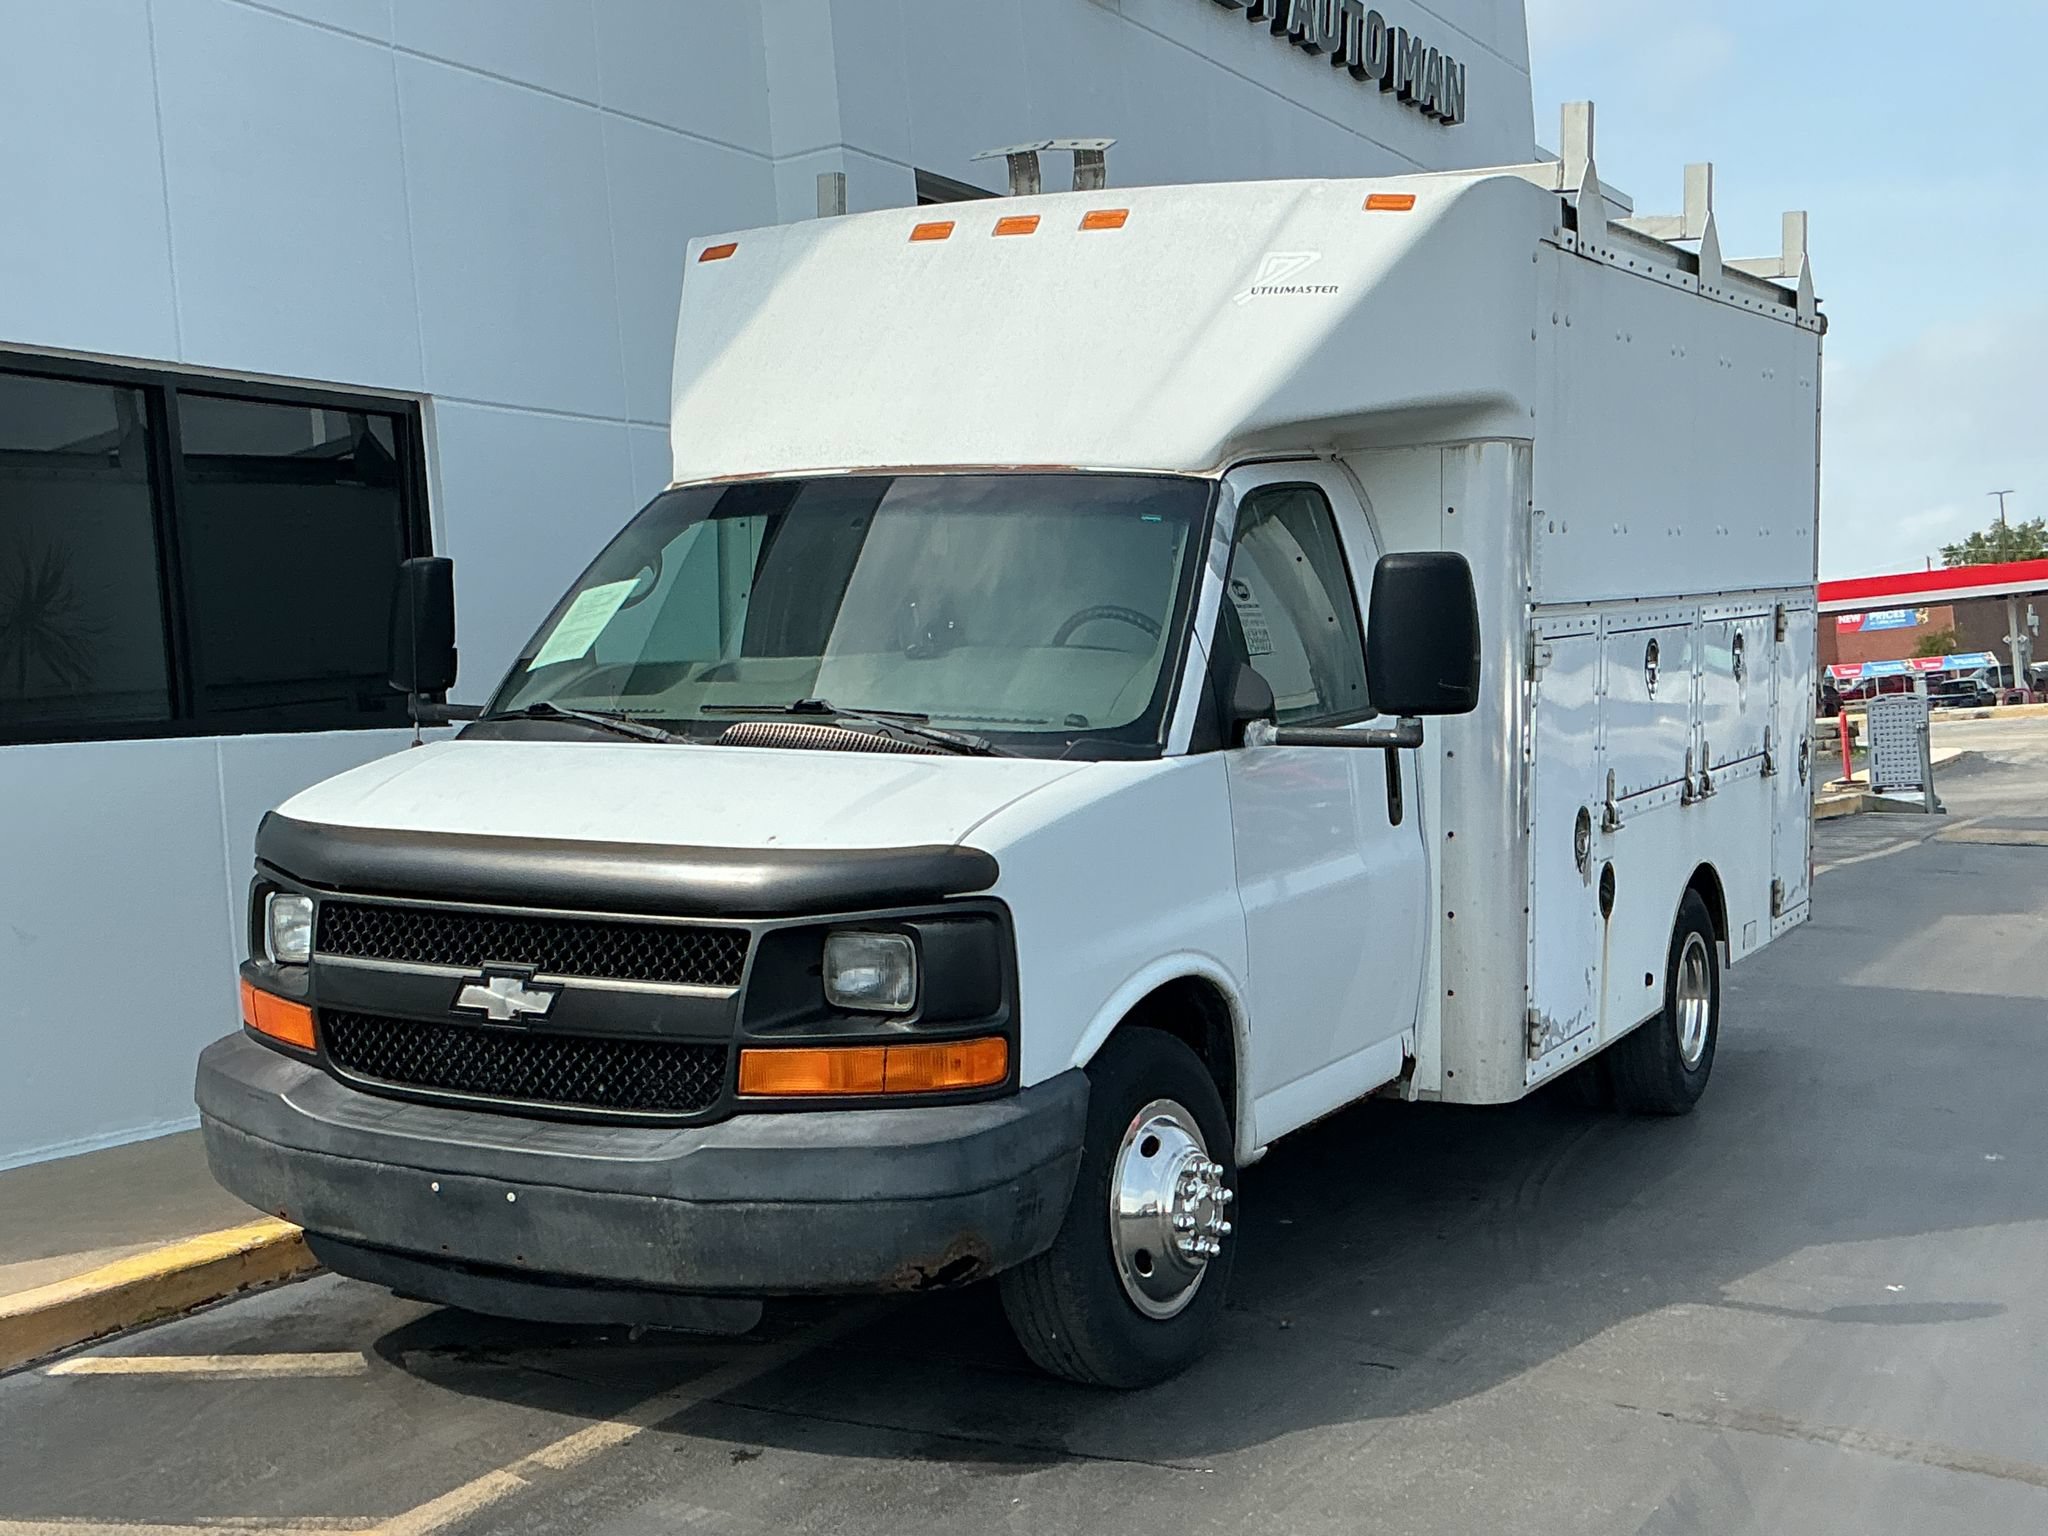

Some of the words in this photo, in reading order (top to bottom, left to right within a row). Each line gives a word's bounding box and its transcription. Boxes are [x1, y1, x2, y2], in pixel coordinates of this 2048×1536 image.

[1393, 26, 1467, 124] MAN
[1250, 285, 1339, 295] UTILIMASTER
[1837, 614, 1860, 624] NEW
